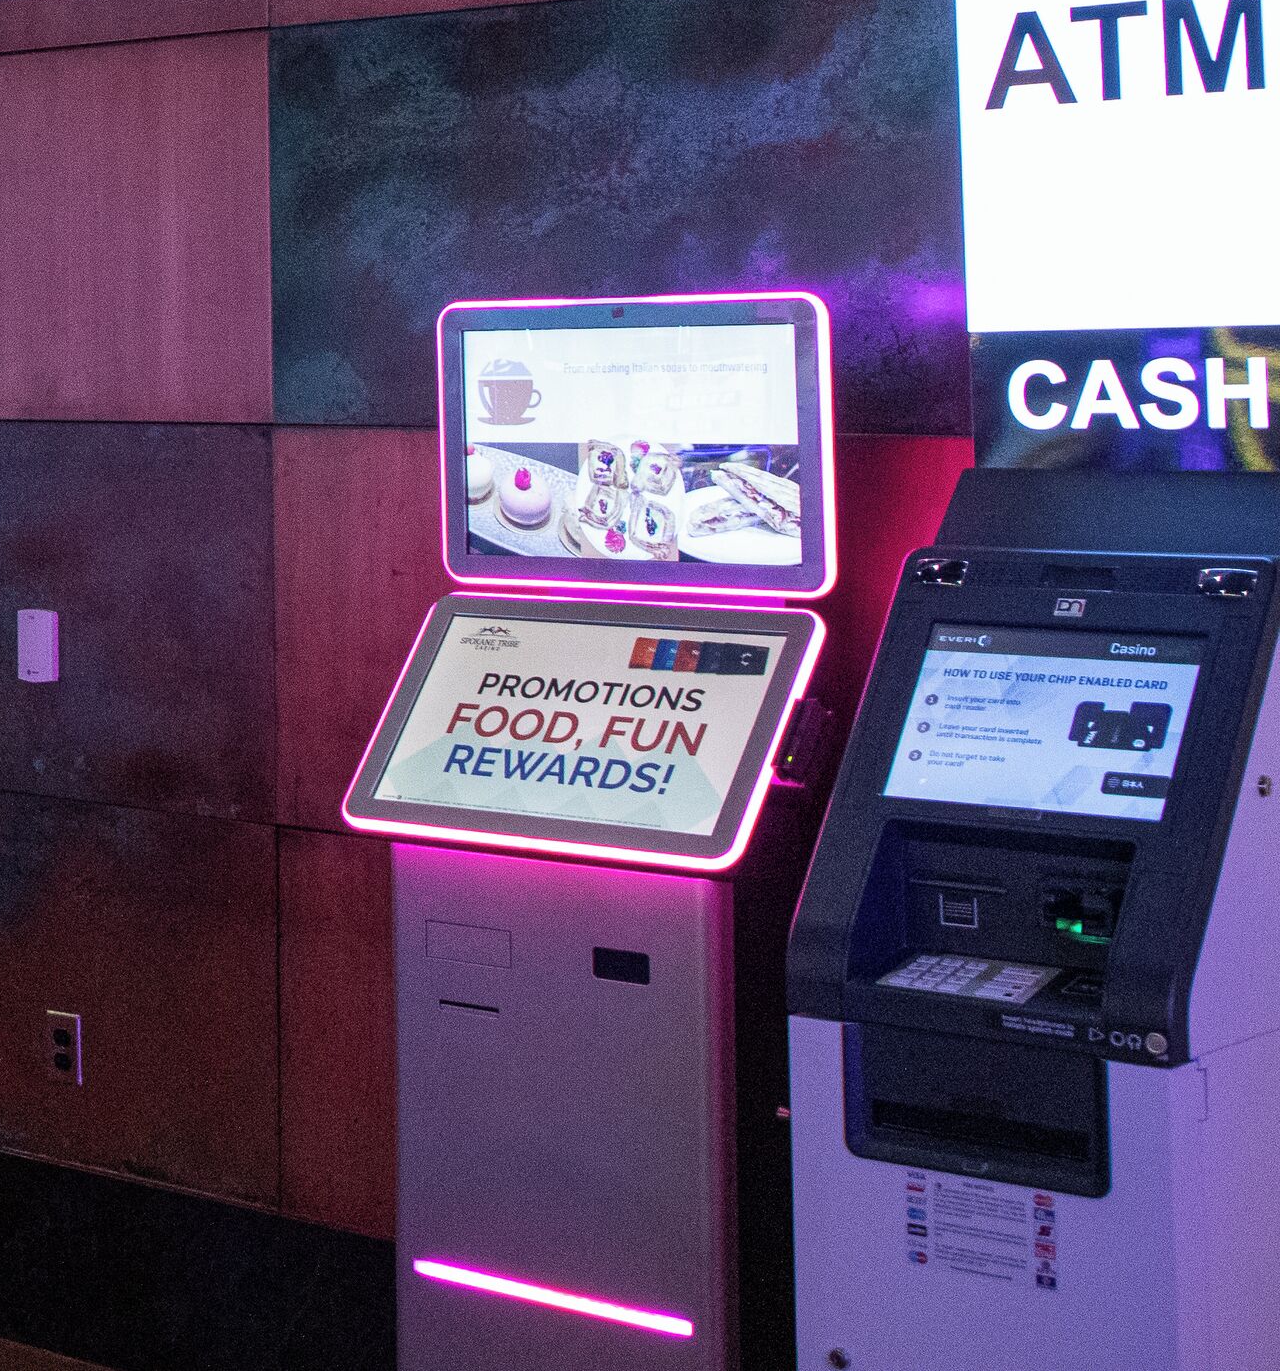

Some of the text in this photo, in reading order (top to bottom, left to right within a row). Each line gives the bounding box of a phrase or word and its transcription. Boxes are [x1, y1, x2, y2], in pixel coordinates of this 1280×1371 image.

[1007, 357, 1270, 430] CASH
[459, 637, 520, 648] SPOKANE TRIBE
[1110, 642, 1156, 656] Casino
[477, 672, 705, 712] PROMOTIONS
[943, 668, 1168, 690] HOW TO USE YOUR CHIP ENABLED CARD
[444, 702, 709, 757] FOOD, FUN
[442, 744, 675, 795] REWARDS!
